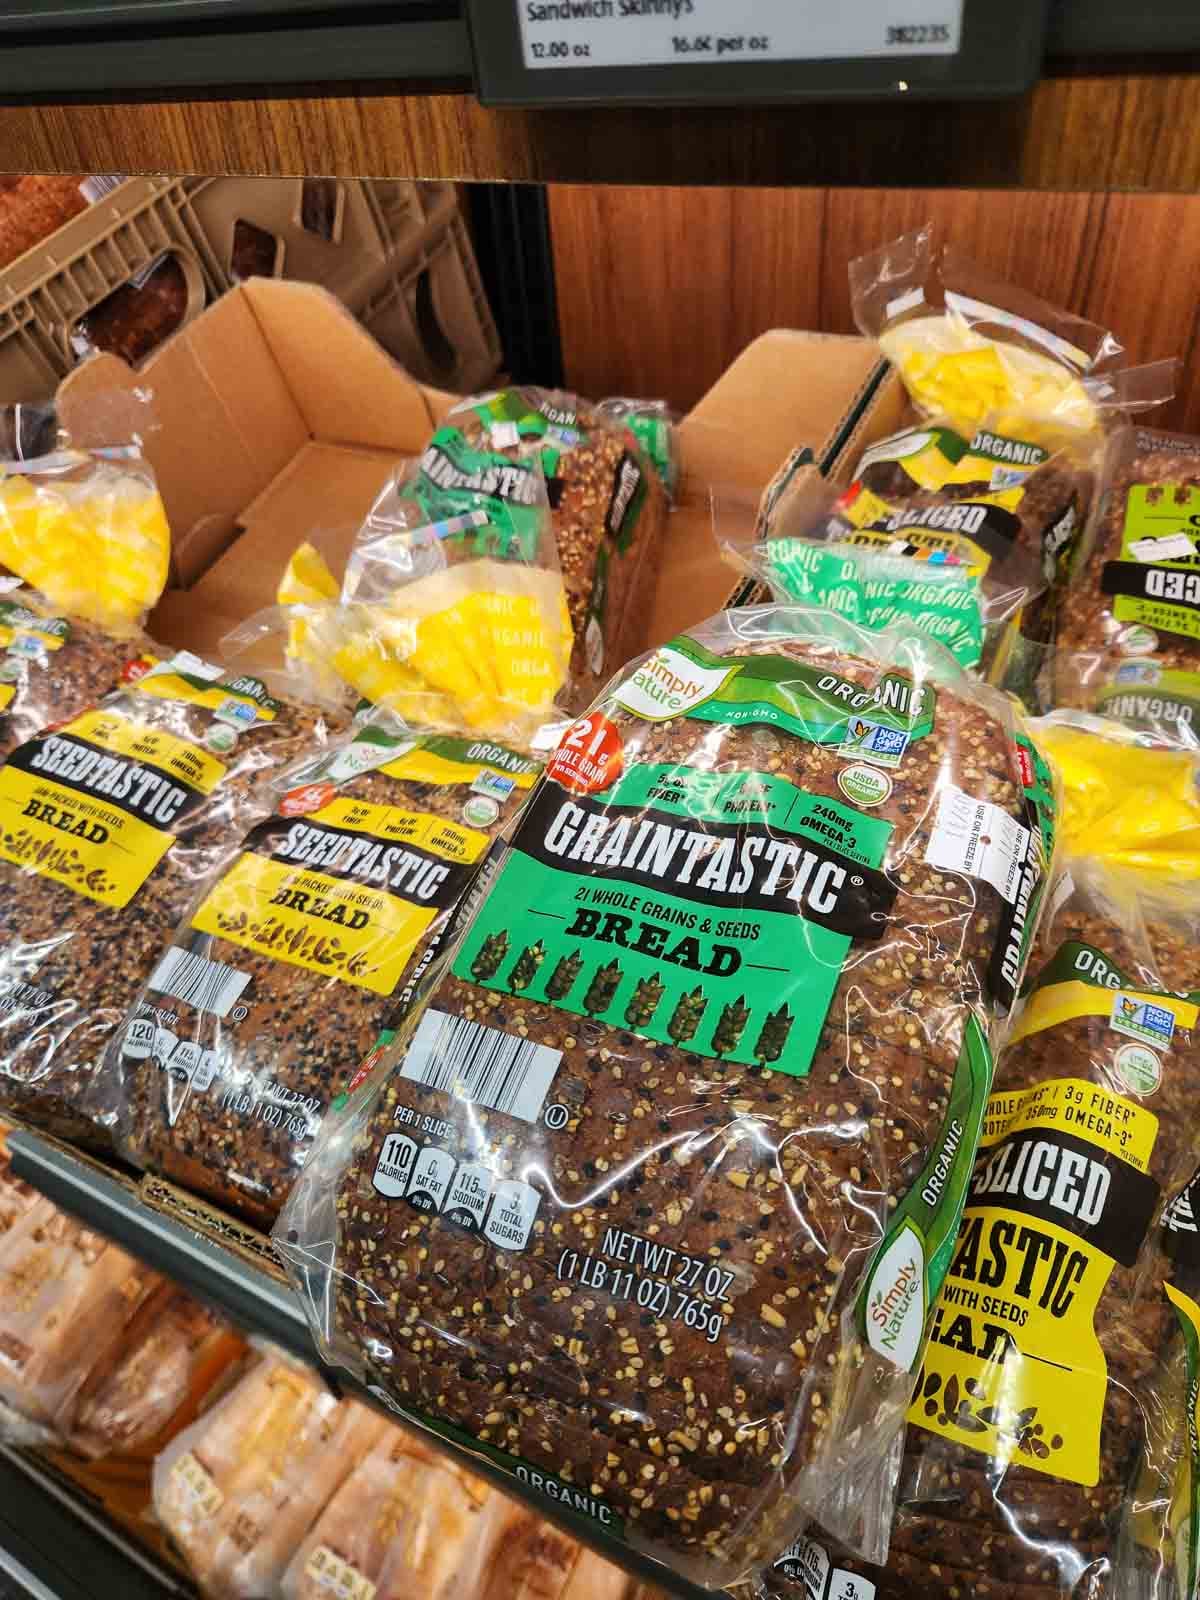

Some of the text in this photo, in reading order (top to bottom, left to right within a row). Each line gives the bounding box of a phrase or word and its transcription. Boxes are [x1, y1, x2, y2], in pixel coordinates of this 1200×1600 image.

[527, 0, 613, 21] Sandwich
[531, 42, 591, 58] 12.00 oz
[716, 37, 745, 54] per
[749, 37, 768, 50] oz
[819, 675, 926, 717] ORGANIC
[876, 736, 903, 749] GMO
[879, 729, 904, 742] NON
[31, 737, 188, 824] SEEDTASTIC
[853, 770, 880, 787] USDA
[21, 798, 109, 844] BREAD
[812, 803, 854, 832] 240mg
[800, 816, 857, 849] OMEGA-3
[280, 822, 450, 900] SEEDTASTIC
[269, 887, 369, 929] BREAD
[574, 885, 762, 941] 21 WHOLE GRAINS & SEEDS
[565, 907, 742, 977] BREAD
[1146, 1014, 1171, 1029] GMO
[1147, 1008, 1172, 1020] NON
[132, 1024, 154, 1041] 120
[1064, 1086, 1084, 1104] 3g
[263, 1104, 283, 1128] OZ)
[283, 1112, 308, 1141] 765g
[394, 1105, 451, 1139] PER 1 SLICE
[386, 1139, 412, 1169] 110
[920, 1119, 964, 1208] ORGANIC
[376, 1161, 408, 1184] CALORIES
[416, 1174, 443, 1194] SAT FAT
[421, 1198, 432, 1210] DV
[452, 1190, 485, 1211] SODIUM
[462, 1216, 473, 1228] DV
[490, 1221, 524, 1245] SUGARS
[500, 1209, 522, 1228] TOTAL
[602, 1227, 735, 1301] NET WT 27 OZ
[557, 1247, 724, 1342] (1 LB 11 OZ) 765g
[872, 1258, 917, 1328] Simply
[943, 1284, 1029, 1328] WITH SEEDS
[880, 1280, 921, 1351] Nature
[515, 1465, 612, 1525] ORGANIC
[845, 1581, 859, 1600] 3g
